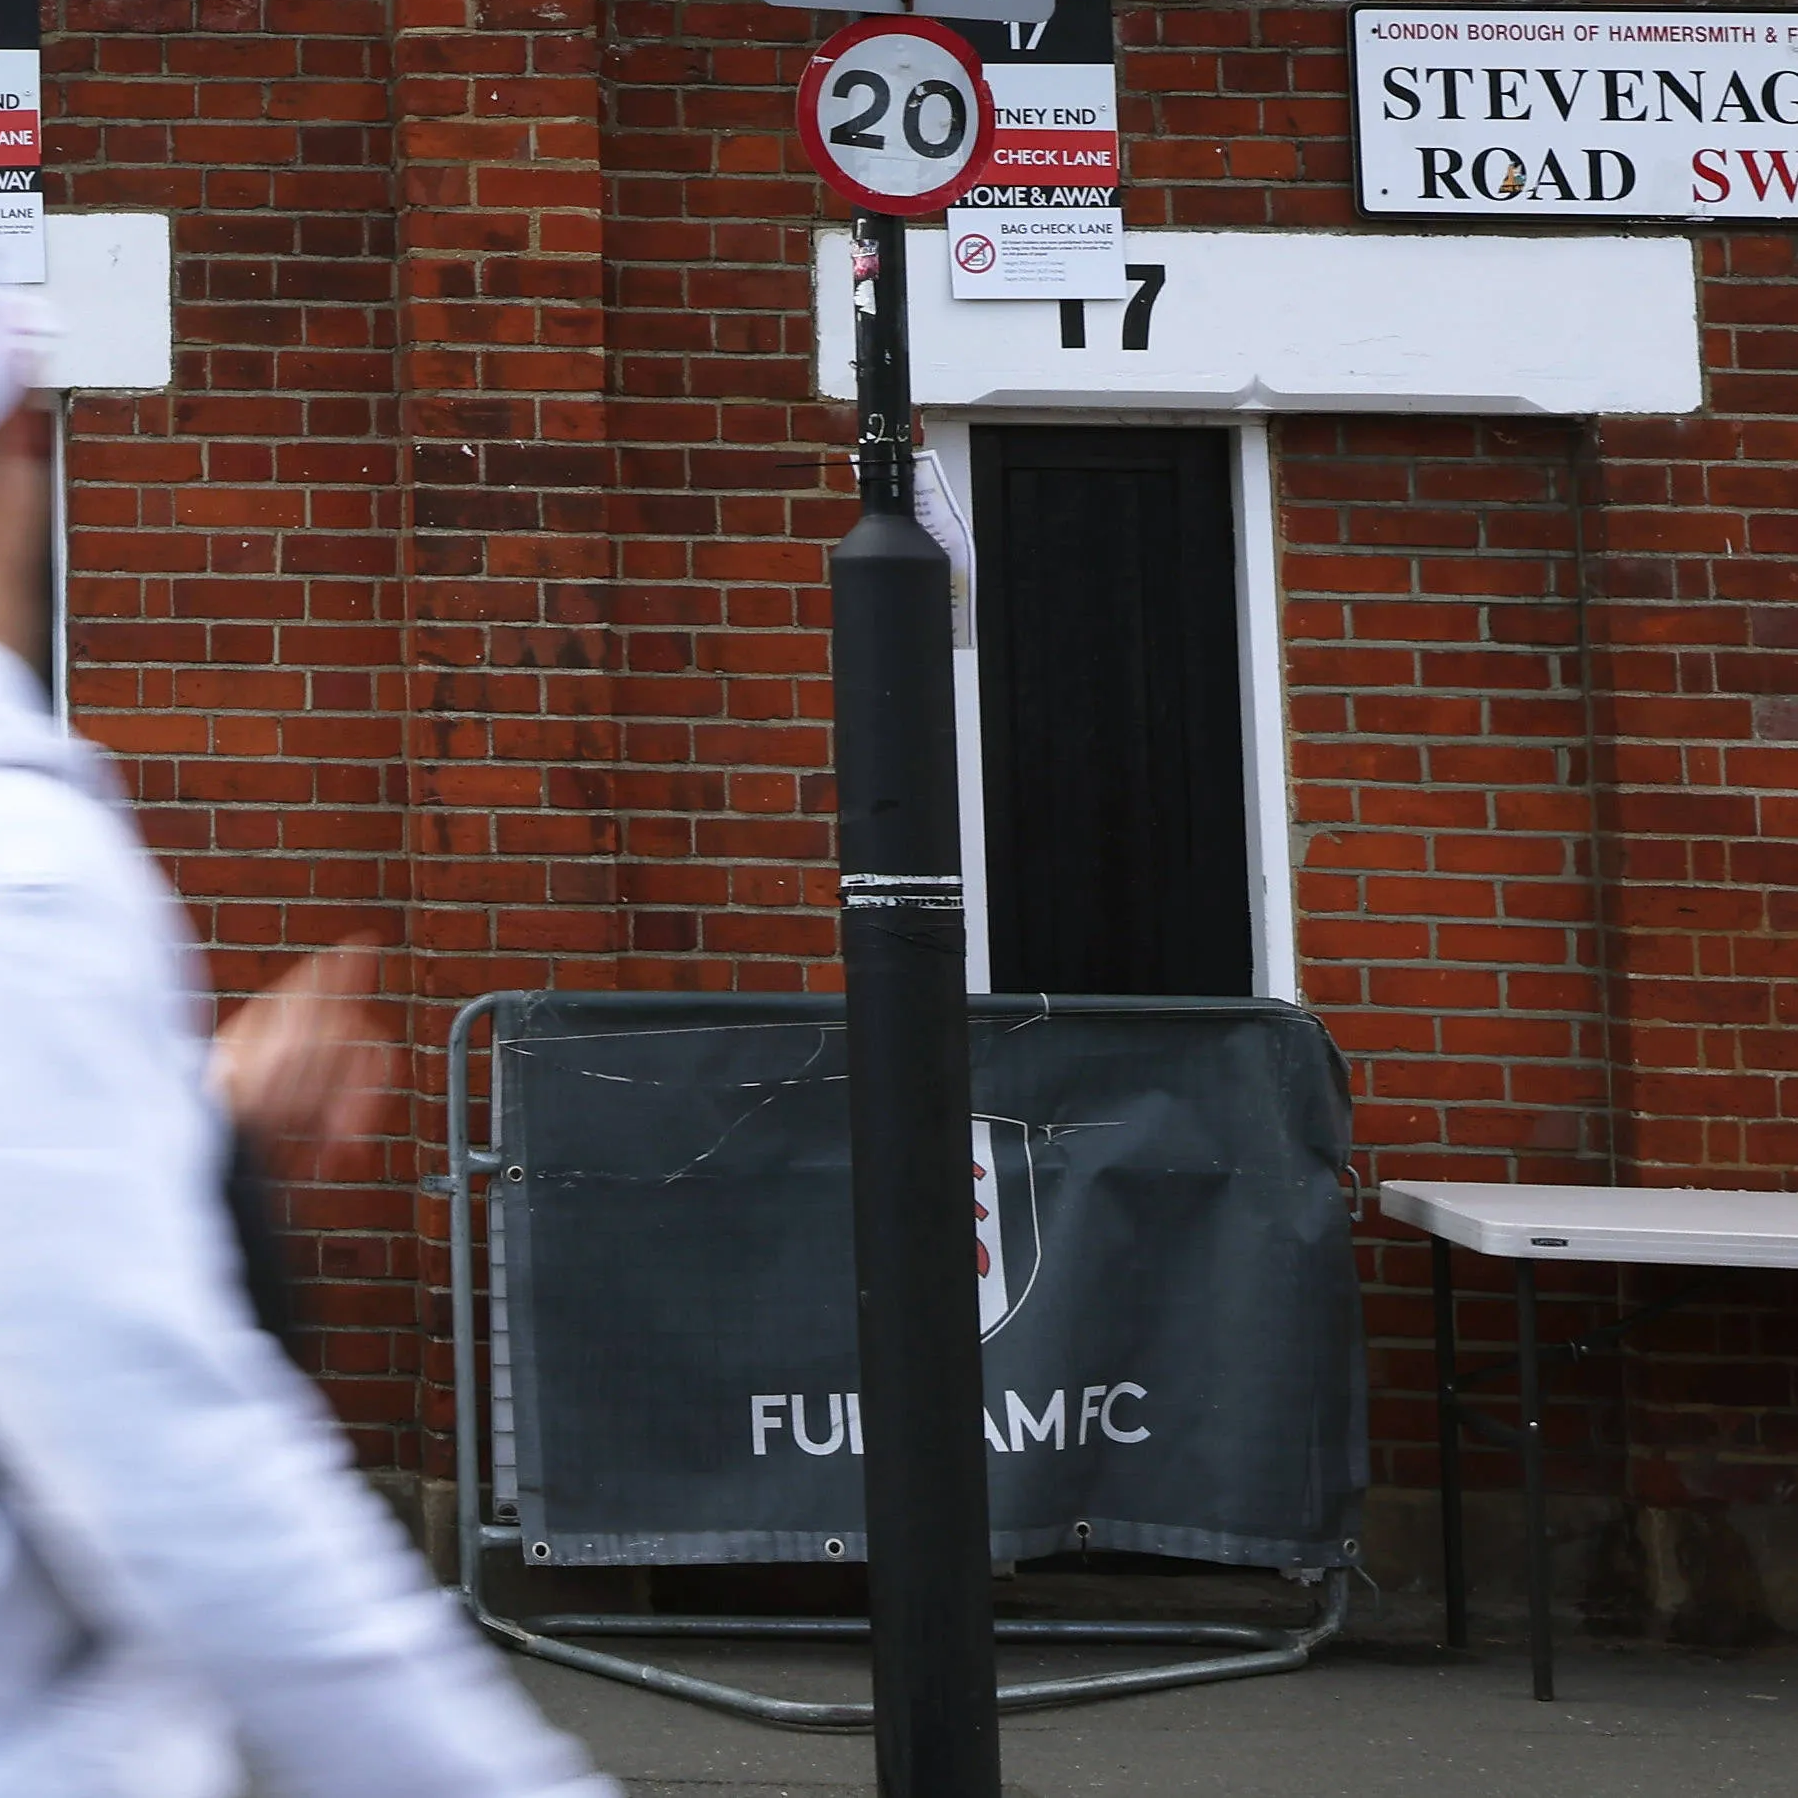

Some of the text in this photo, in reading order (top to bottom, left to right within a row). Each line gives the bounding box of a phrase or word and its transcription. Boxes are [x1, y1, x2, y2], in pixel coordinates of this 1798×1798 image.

[1378, 23, 1458, 41] LONDON
[1467, 23, 1565, 42] BOROUGH
[1573, 24, 1600, 42] OF
[1609, 25, 1756, 43] HAMMERSMITH
[1765, 26, 1778, 44] &
[828, 68, 968, 159] 20
[995, 108, 1097, 125] TNEY END
[993, 149, 1112, 167] CHECK LANE
[1417, 147, 1798, 204] ROAD SW
[1, 208, 35, 219] LANE
[1001, 223, 1113, 235] BAG CHECK LANE
[1060, 264, 1166, 351] 17
[751, 1381, 1152, 1456] FULM FC
